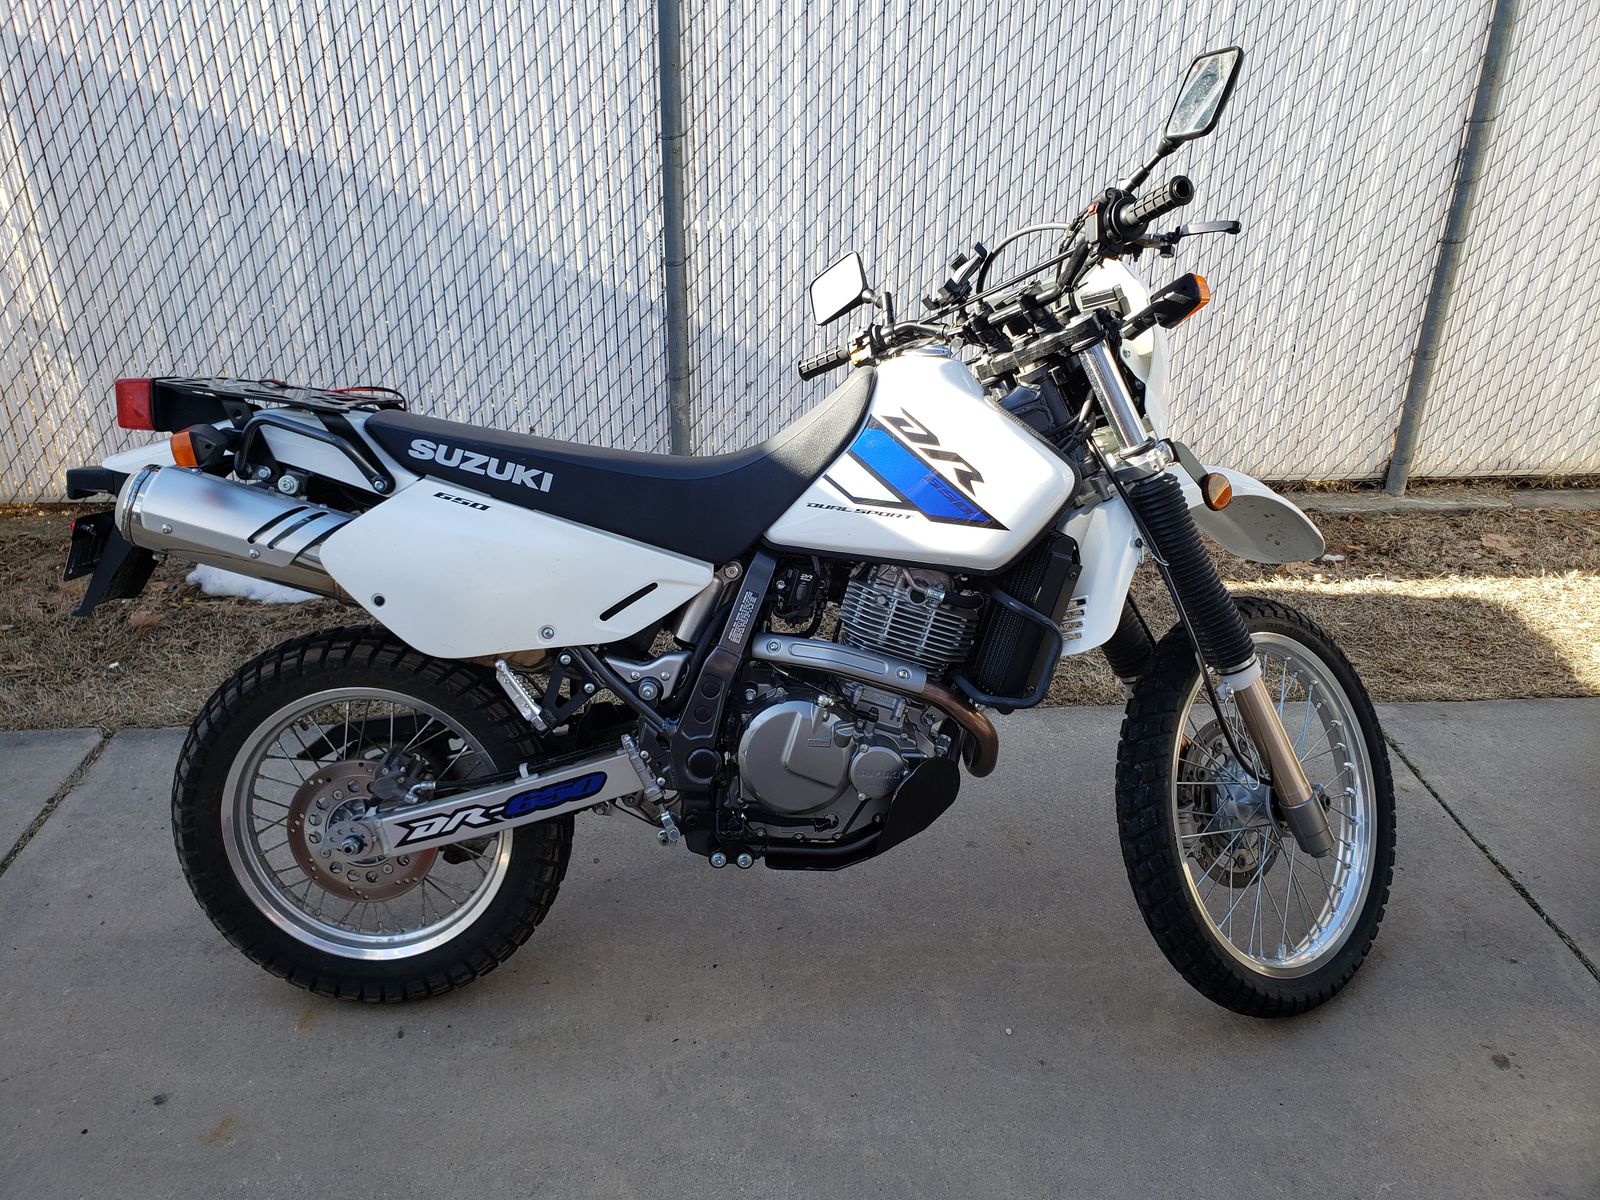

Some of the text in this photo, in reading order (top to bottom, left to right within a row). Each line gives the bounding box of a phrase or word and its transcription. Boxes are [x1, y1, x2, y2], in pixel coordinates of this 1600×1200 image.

[408, 439, 554, 493] SUZUKI
[881, 406, 984, 498] DR
[433, 491, 491, 511] 650
[806, 502, 914, 520] DUAL SPORT
